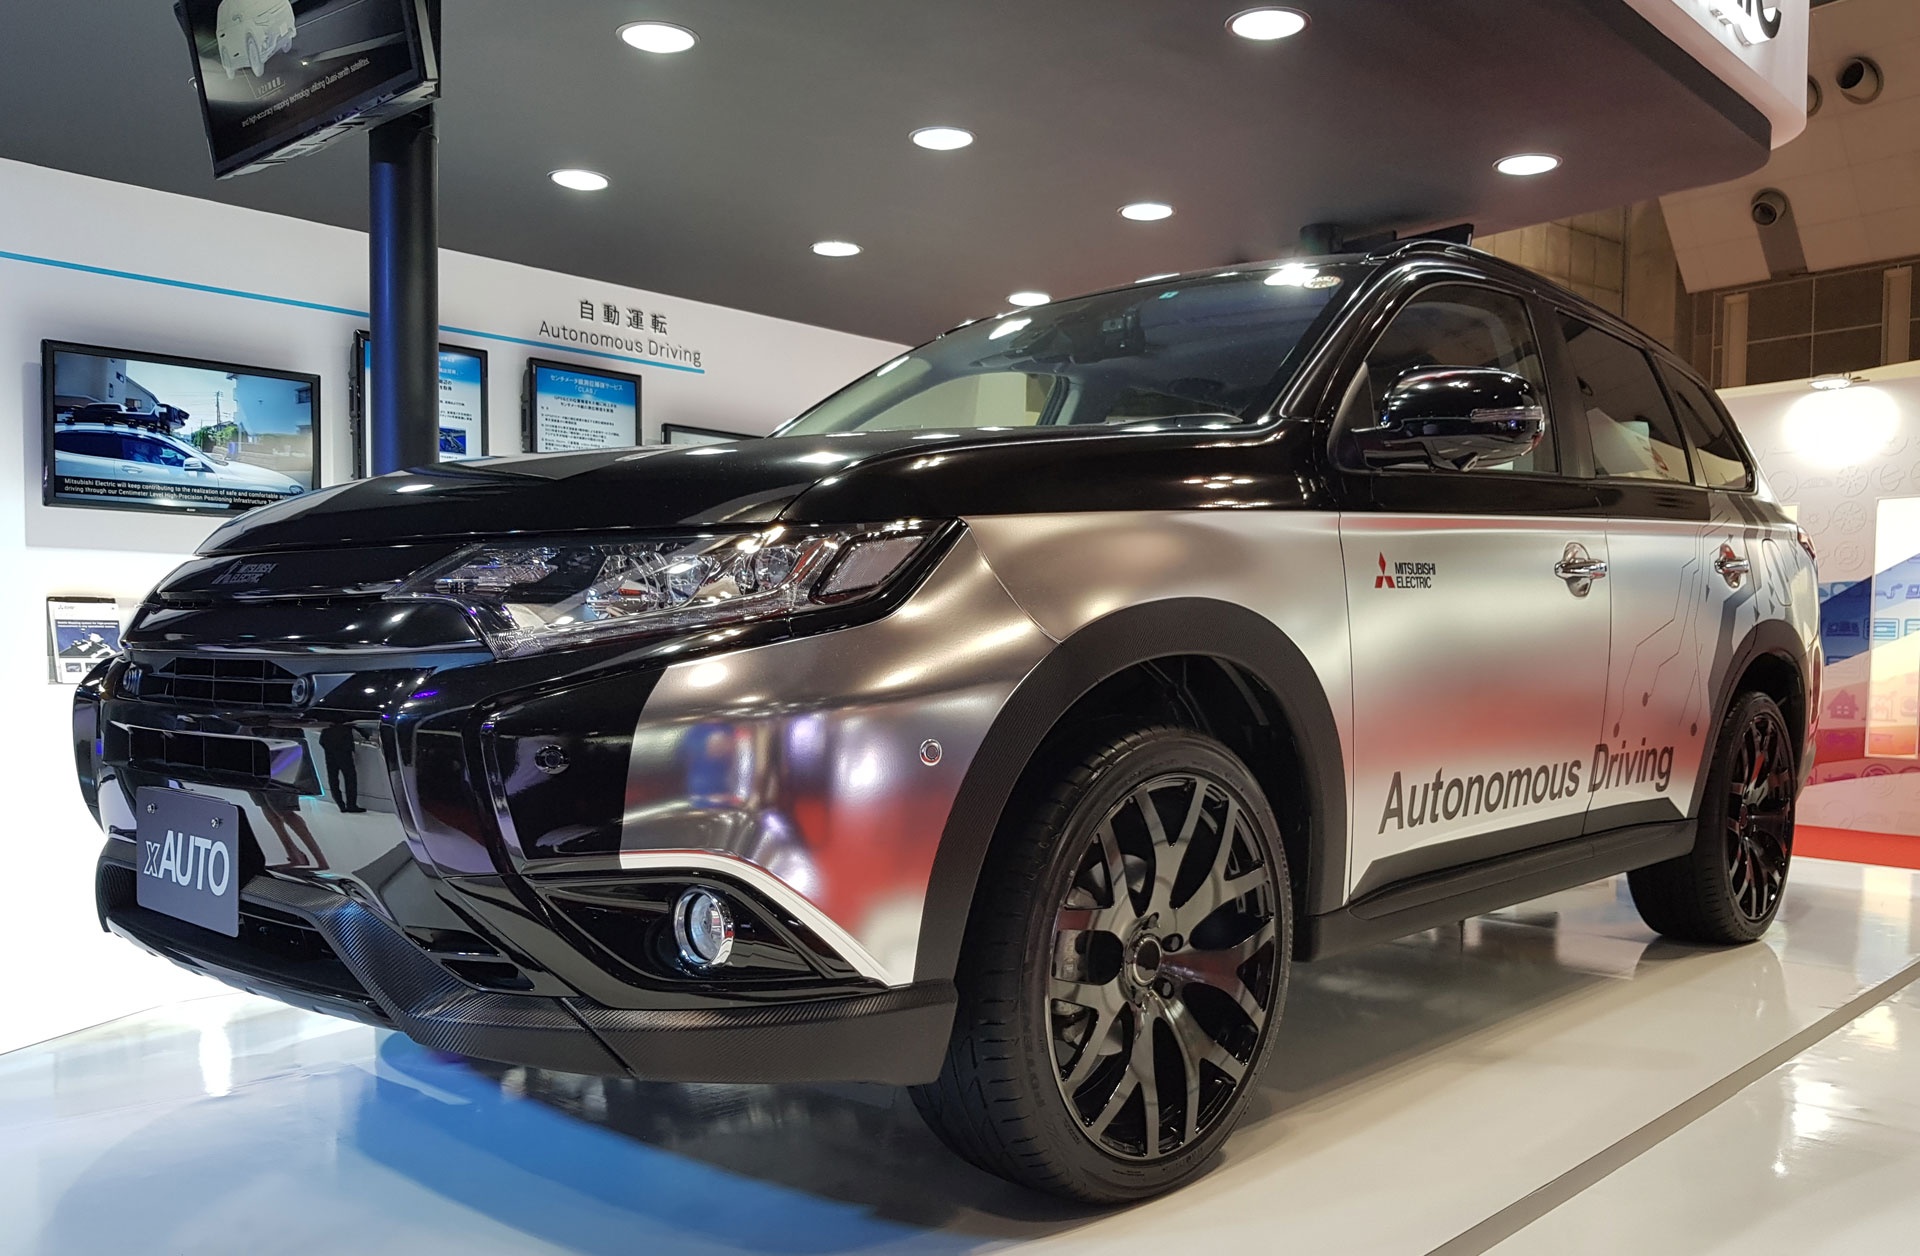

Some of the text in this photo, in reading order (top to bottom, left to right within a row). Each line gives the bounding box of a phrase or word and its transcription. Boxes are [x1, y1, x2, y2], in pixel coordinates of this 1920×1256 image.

[580, 300, 667, 335] 自動運転
[539, 321, 702, 368] Autonomous Driving
[142, 484, 174, 492] contributing
[1394, 562, 1436, 575] MITSUBISHI
[1396, 576, 1432, 588] ELECTRIC
[1378, 737, 1674, 834] Autonomous Driving
[144, 830, 230, 896] xAUTO
